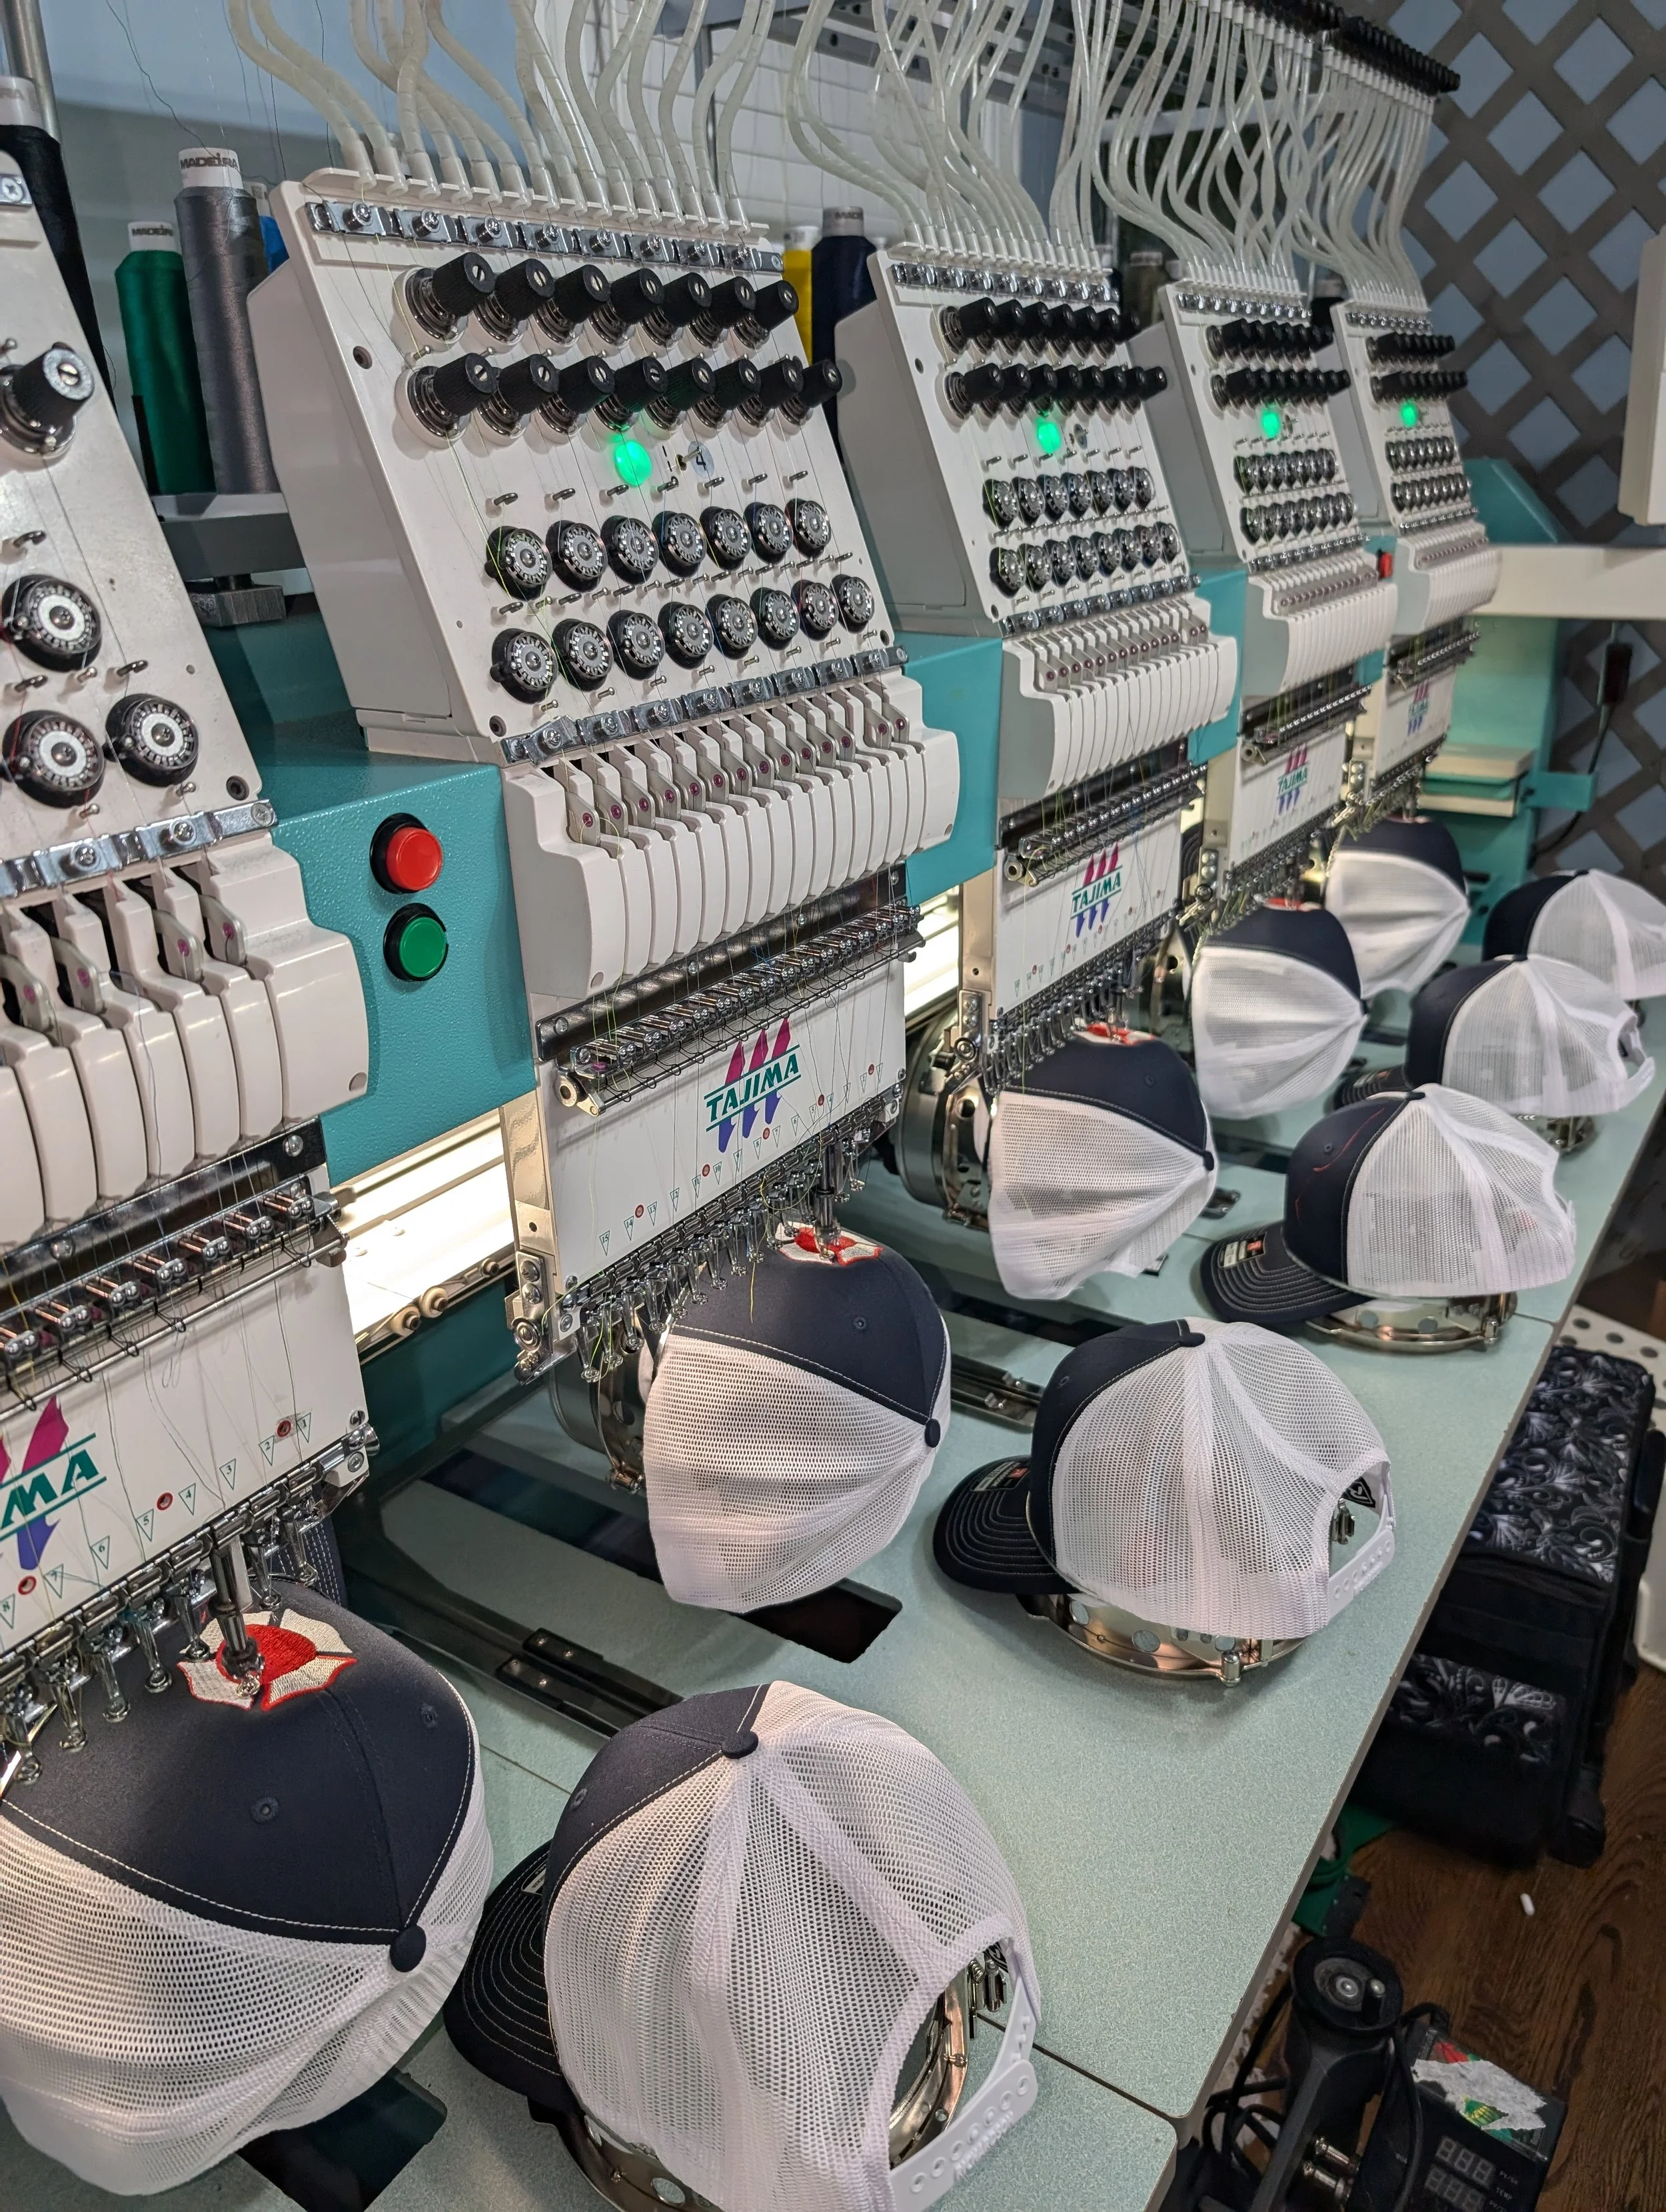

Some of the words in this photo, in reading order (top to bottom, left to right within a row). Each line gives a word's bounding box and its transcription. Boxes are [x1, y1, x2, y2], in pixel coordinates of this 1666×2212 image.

[180, 153, 239, 170] MADEIRA
[1072, 871, 1121, 913] TAJIMA
[706, 1053, 800, 1123] TAJIMA
[602, 1233, 609, 1244] 15
[626, 1219, 633, 1229] 14
[650, 1205, 656, 1214] 13
[714, 1164, 721, 1173] 10
[98, 1543, 106, 1553] 6
[142, 1515, 150, 1526] 5
[185, 1489, 192, 1500] 4
[225, 1464, 233, 1475] 3
[264, 1441, 271, 1451] 2
[301, 1418, 308, 1428] 1
